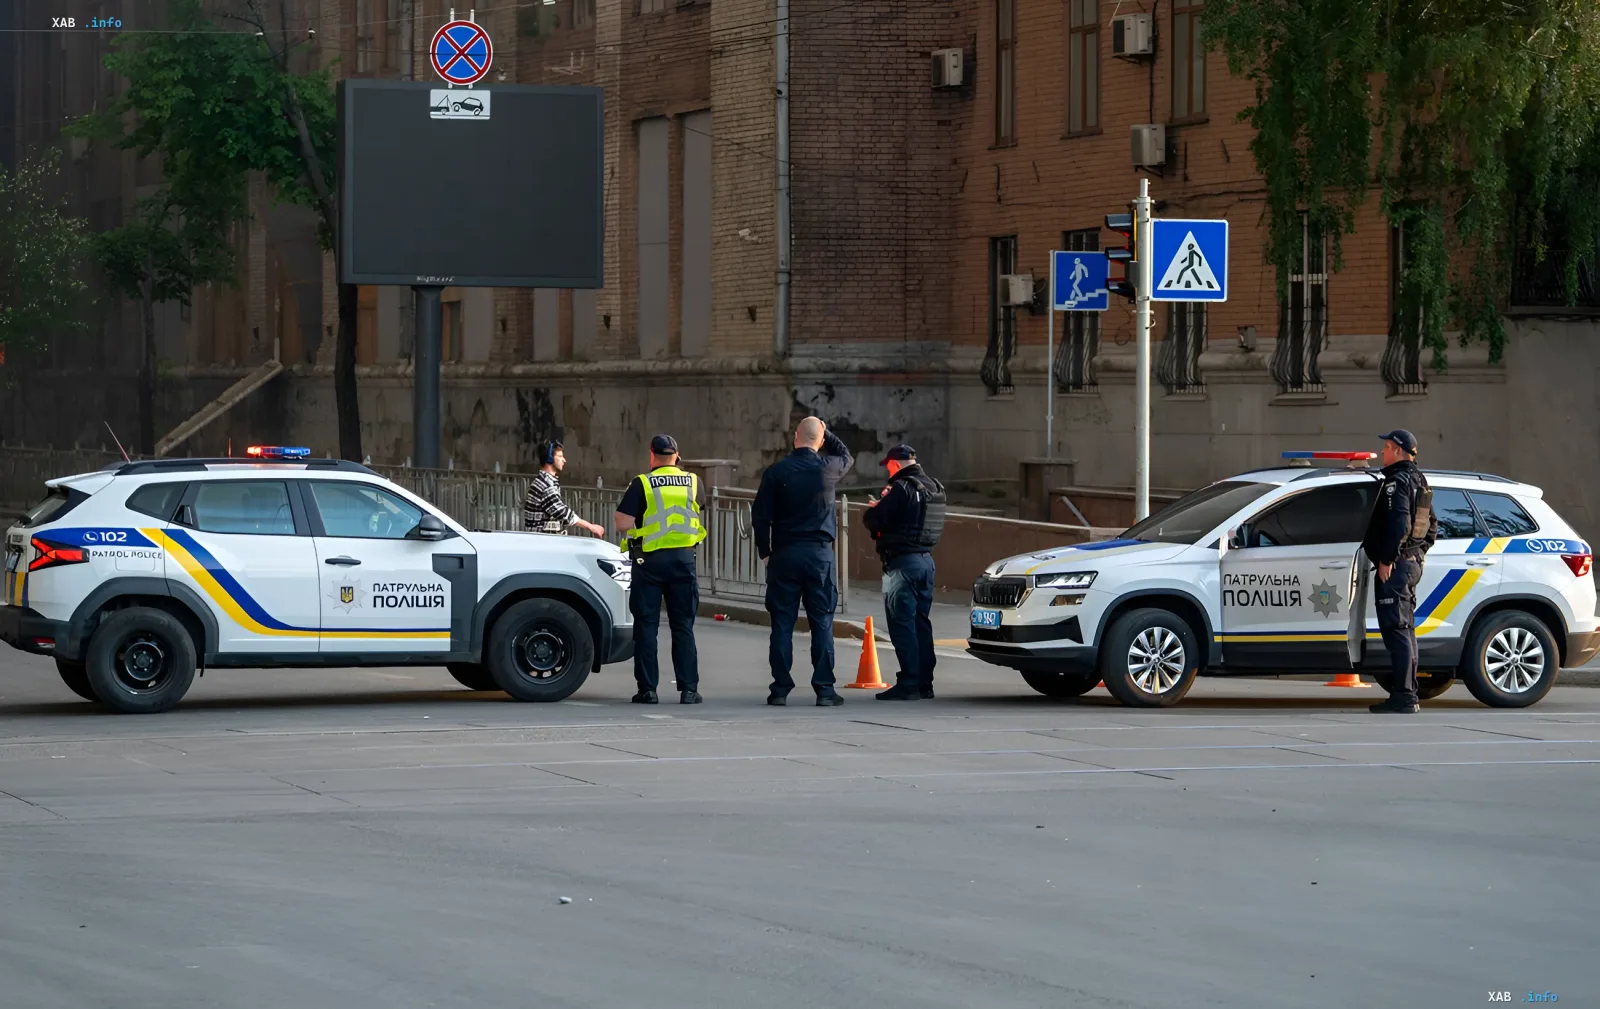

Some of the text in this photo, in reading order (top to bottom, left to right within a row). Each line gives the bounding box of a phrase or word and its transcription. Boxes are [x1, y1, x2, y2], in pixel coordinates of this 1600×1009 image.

[100, 531, 127, 542] 102
[1541, 540, 1568, 551] 102
[1223, 574, 1301, 586] ПАТРУЛЬНА
[373, 583, 444, 592] ПАТРУЛЬНА
[373, 595, 445, 608] ПОЛІЦІЯ
[1223, 590, 1302, 607] ПОЛІЦІЯ
